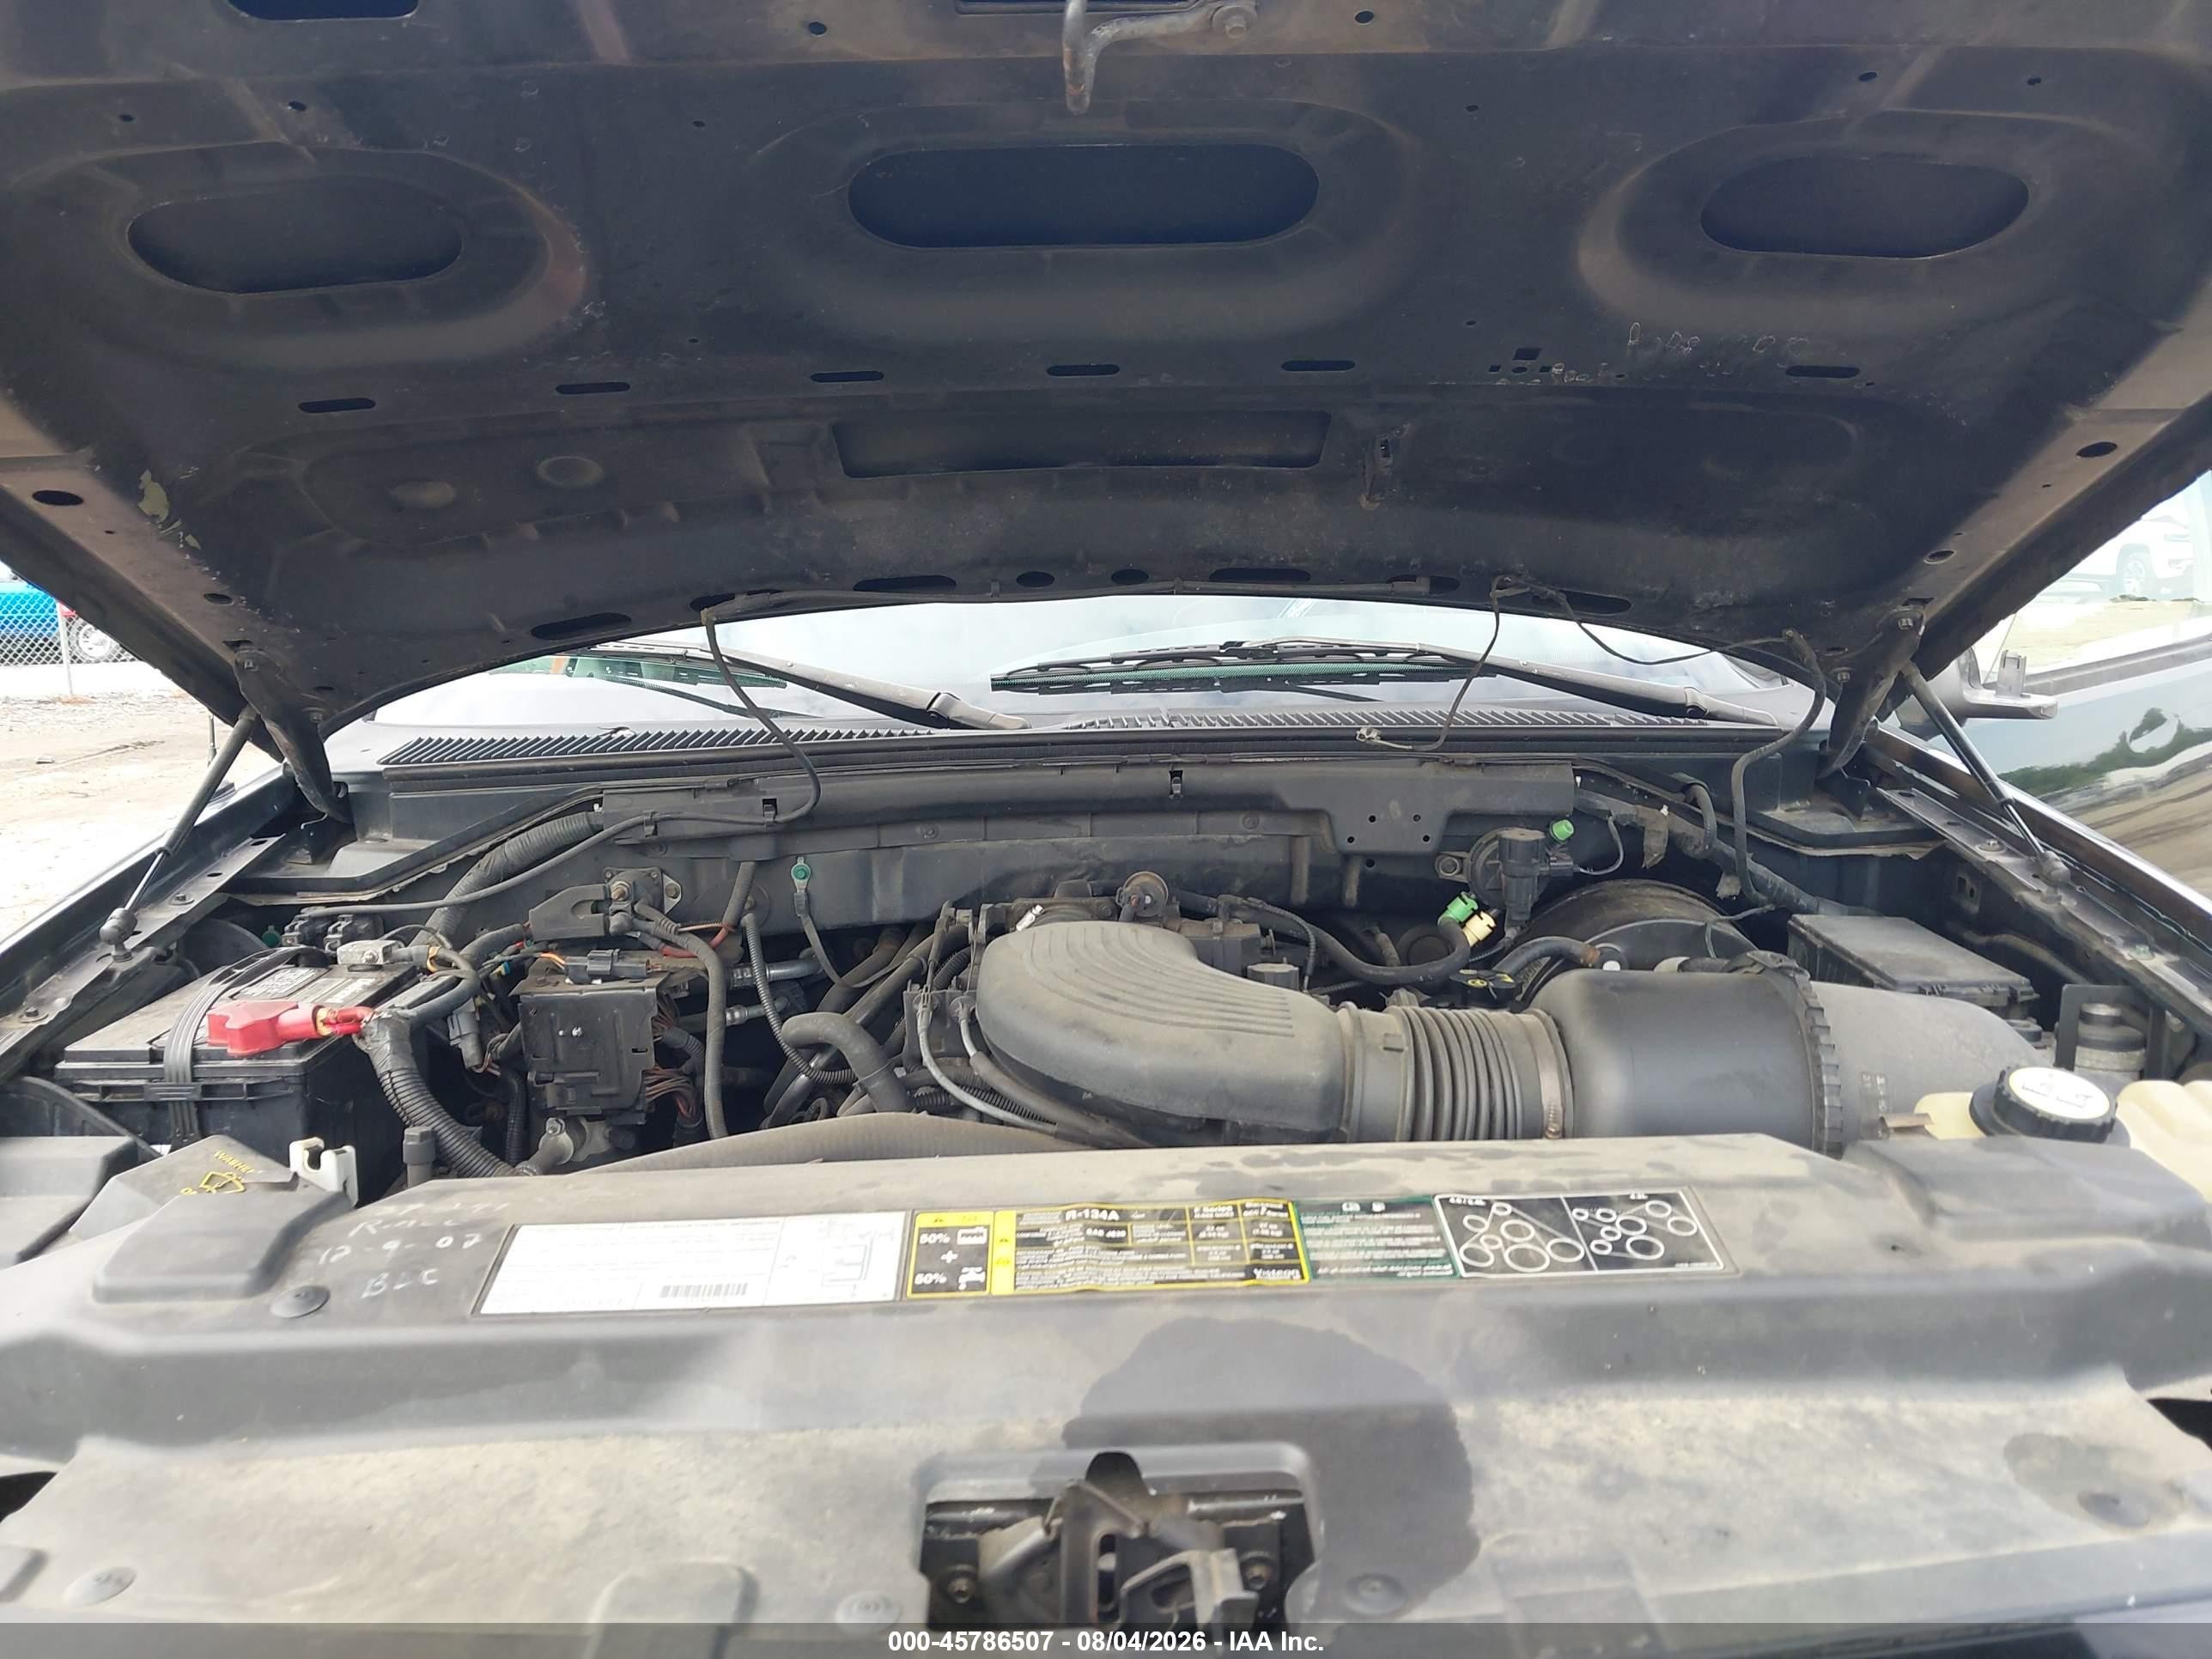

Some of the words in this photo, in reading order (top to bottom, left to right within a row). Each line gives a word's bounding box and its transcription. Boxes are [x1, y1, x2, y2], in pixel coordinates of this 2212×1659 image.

[1065, 1209, 1120, 1221] R-134A
[919, 1232, 951, 1244] 50%
[914, 1273, 947, 1285] 50%
